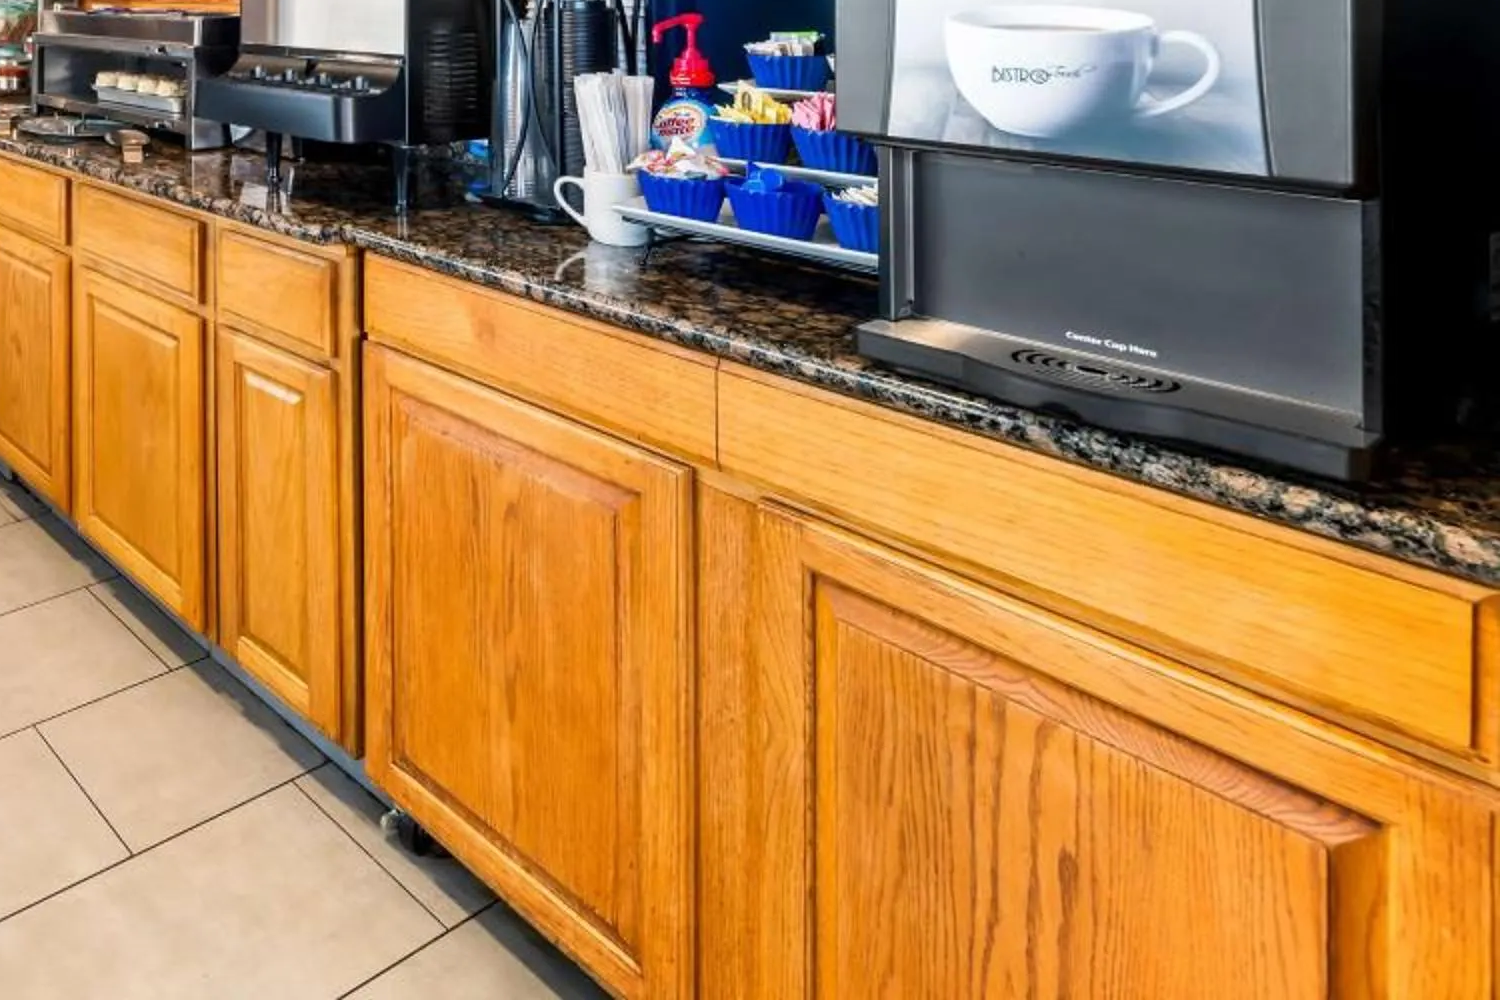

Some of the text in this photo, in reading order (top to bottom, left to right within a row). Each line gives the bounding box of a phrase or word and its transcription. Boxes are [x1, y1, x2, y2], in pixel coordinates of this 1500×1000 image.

[991, 65, 1049, 85] BISTRO
[1065, 331, 1158, 358] Center Cup Here
